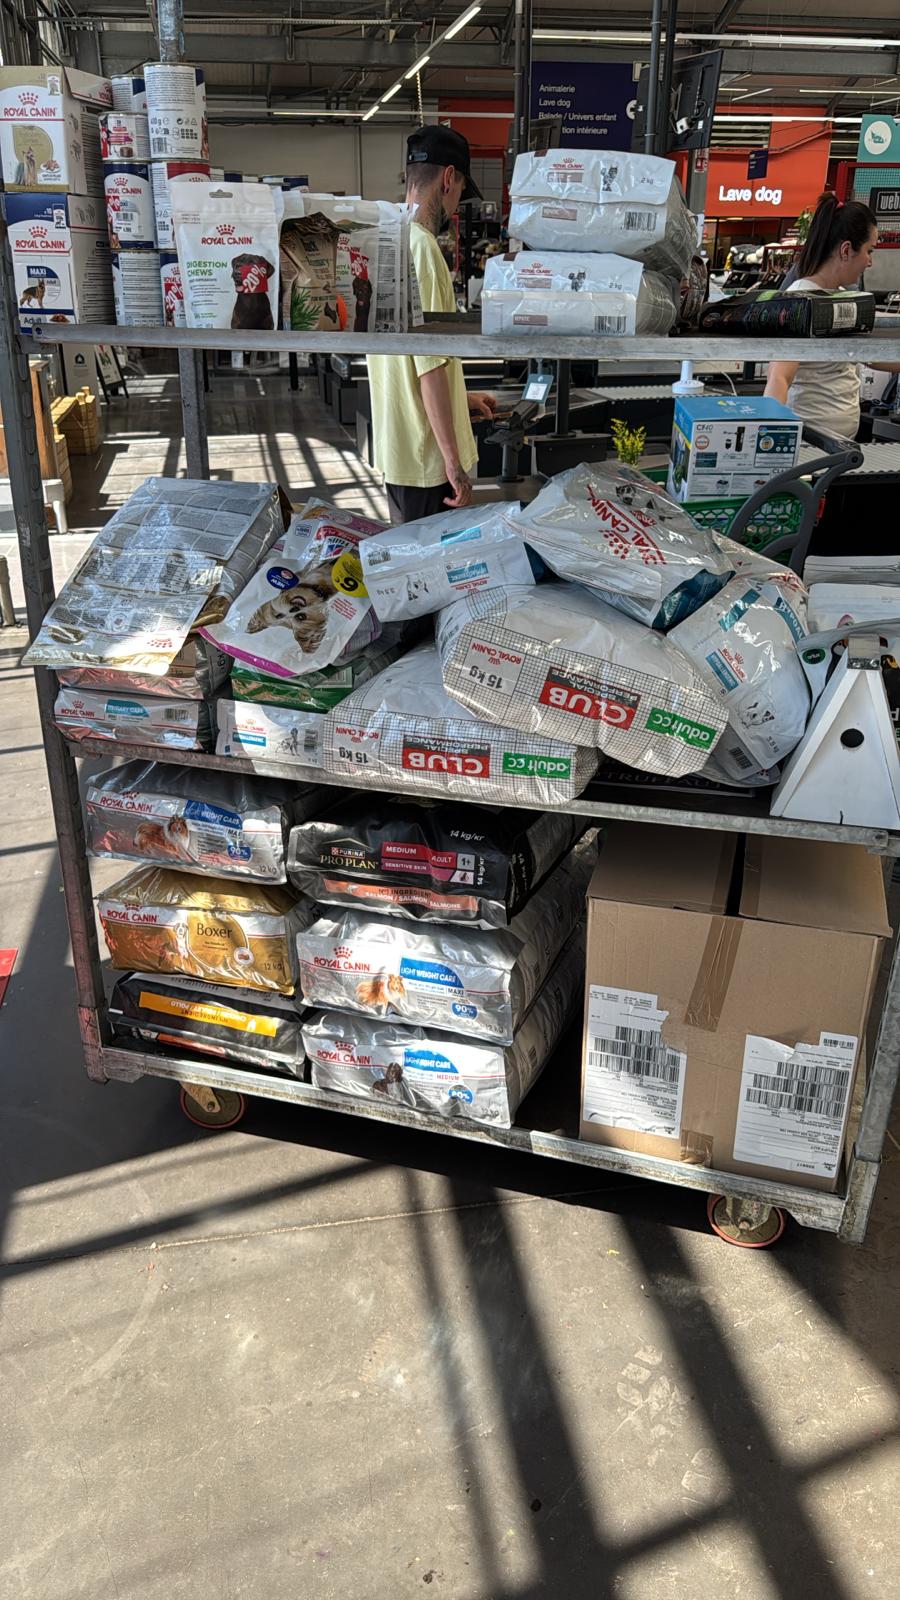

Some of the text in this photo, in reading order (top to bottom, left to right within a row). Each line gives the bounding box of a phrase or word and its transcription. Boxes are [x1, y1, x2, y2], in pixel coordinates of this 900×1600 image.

[539, 84, 576, 93] Animalerie
[539, 98, 571, 108] Lave dog
[3, 108, 56, 117] ROYAL CANIN
[539, 112, 562, 120] Balade
[568, 113, 594, 121] Univers
[576, 127, 608, 135] intérieure
[719, 186, 783, 205] Lave dog
[880, 191, 900, 210] web
[15, 240, 66, 249] ROYAL CANIN
[201, 237, 253, 245] ROYAL CANIN
[186, 261, 228, 269] DIGESTION
[187, 269, 214, 277] CHEWS
[243, 264, 267, 293] -20%
[269, 577, 286, 588] NEW
[779, 601, 805, 638] HYPOAL
[472, 643, 521, 664] ROYAL CANIN
[469, 665, 503, 689] 15 kg
[552, 670, 638, 701] PERFORMANCE
[569, 680, 617, 700] SPECIAL
[550, 687, 628, 724] CLUB
[336, 727, 357, 735] CANIN
[652, 713, 710, 740] adult cc
[407, 737, 489, 751] PERFORMANCE
[424, 743, 469, 755] SPECIAL
[339, 746, 369, 764] 15 kg
[409, 751, 484, 774] CLUB
[507, 756, 568, 772] adult cc
[100, 796, 153, 812] ROYAL CANIN
[223, 815, 240, 825] CARE
[450, 830, 460, 838] 14
[230, 847, 248, 856] 90%
[339, 850, 365, 858] PURINA
[386, 846, 417, 855] MEDIUM
[320, 855, 376, 870] PRO PLAN
[431, 855, 453, 864] ADULT
[461, 858, 472, 866] 1+
[260, 865, 278, 875] 12 kg
[391, 888, 432, 899] INGREDIENT
[365, 892, 393, 902] SALMON
[398, 895, 428, 905] SAUMON
[429, 900, 462, 909] SALMONE
[107, 910, 158, 923] ROYAL CANIN
[197, 922, 233, 939] Boxer
[264, 962, 283, 972] 12 kg
[314, 956, 371, 972] ROYAL CANIN
[401, 966, 457, 982] LIGHT WEIGHT CARE
[171, 1000, 190, 1010] POLLO
[455, 1004, 475, 1014] 90%
[317, 1050, 371, 1065] ROYAL CANIN
[435, 1060, 452, 1069] CARE
